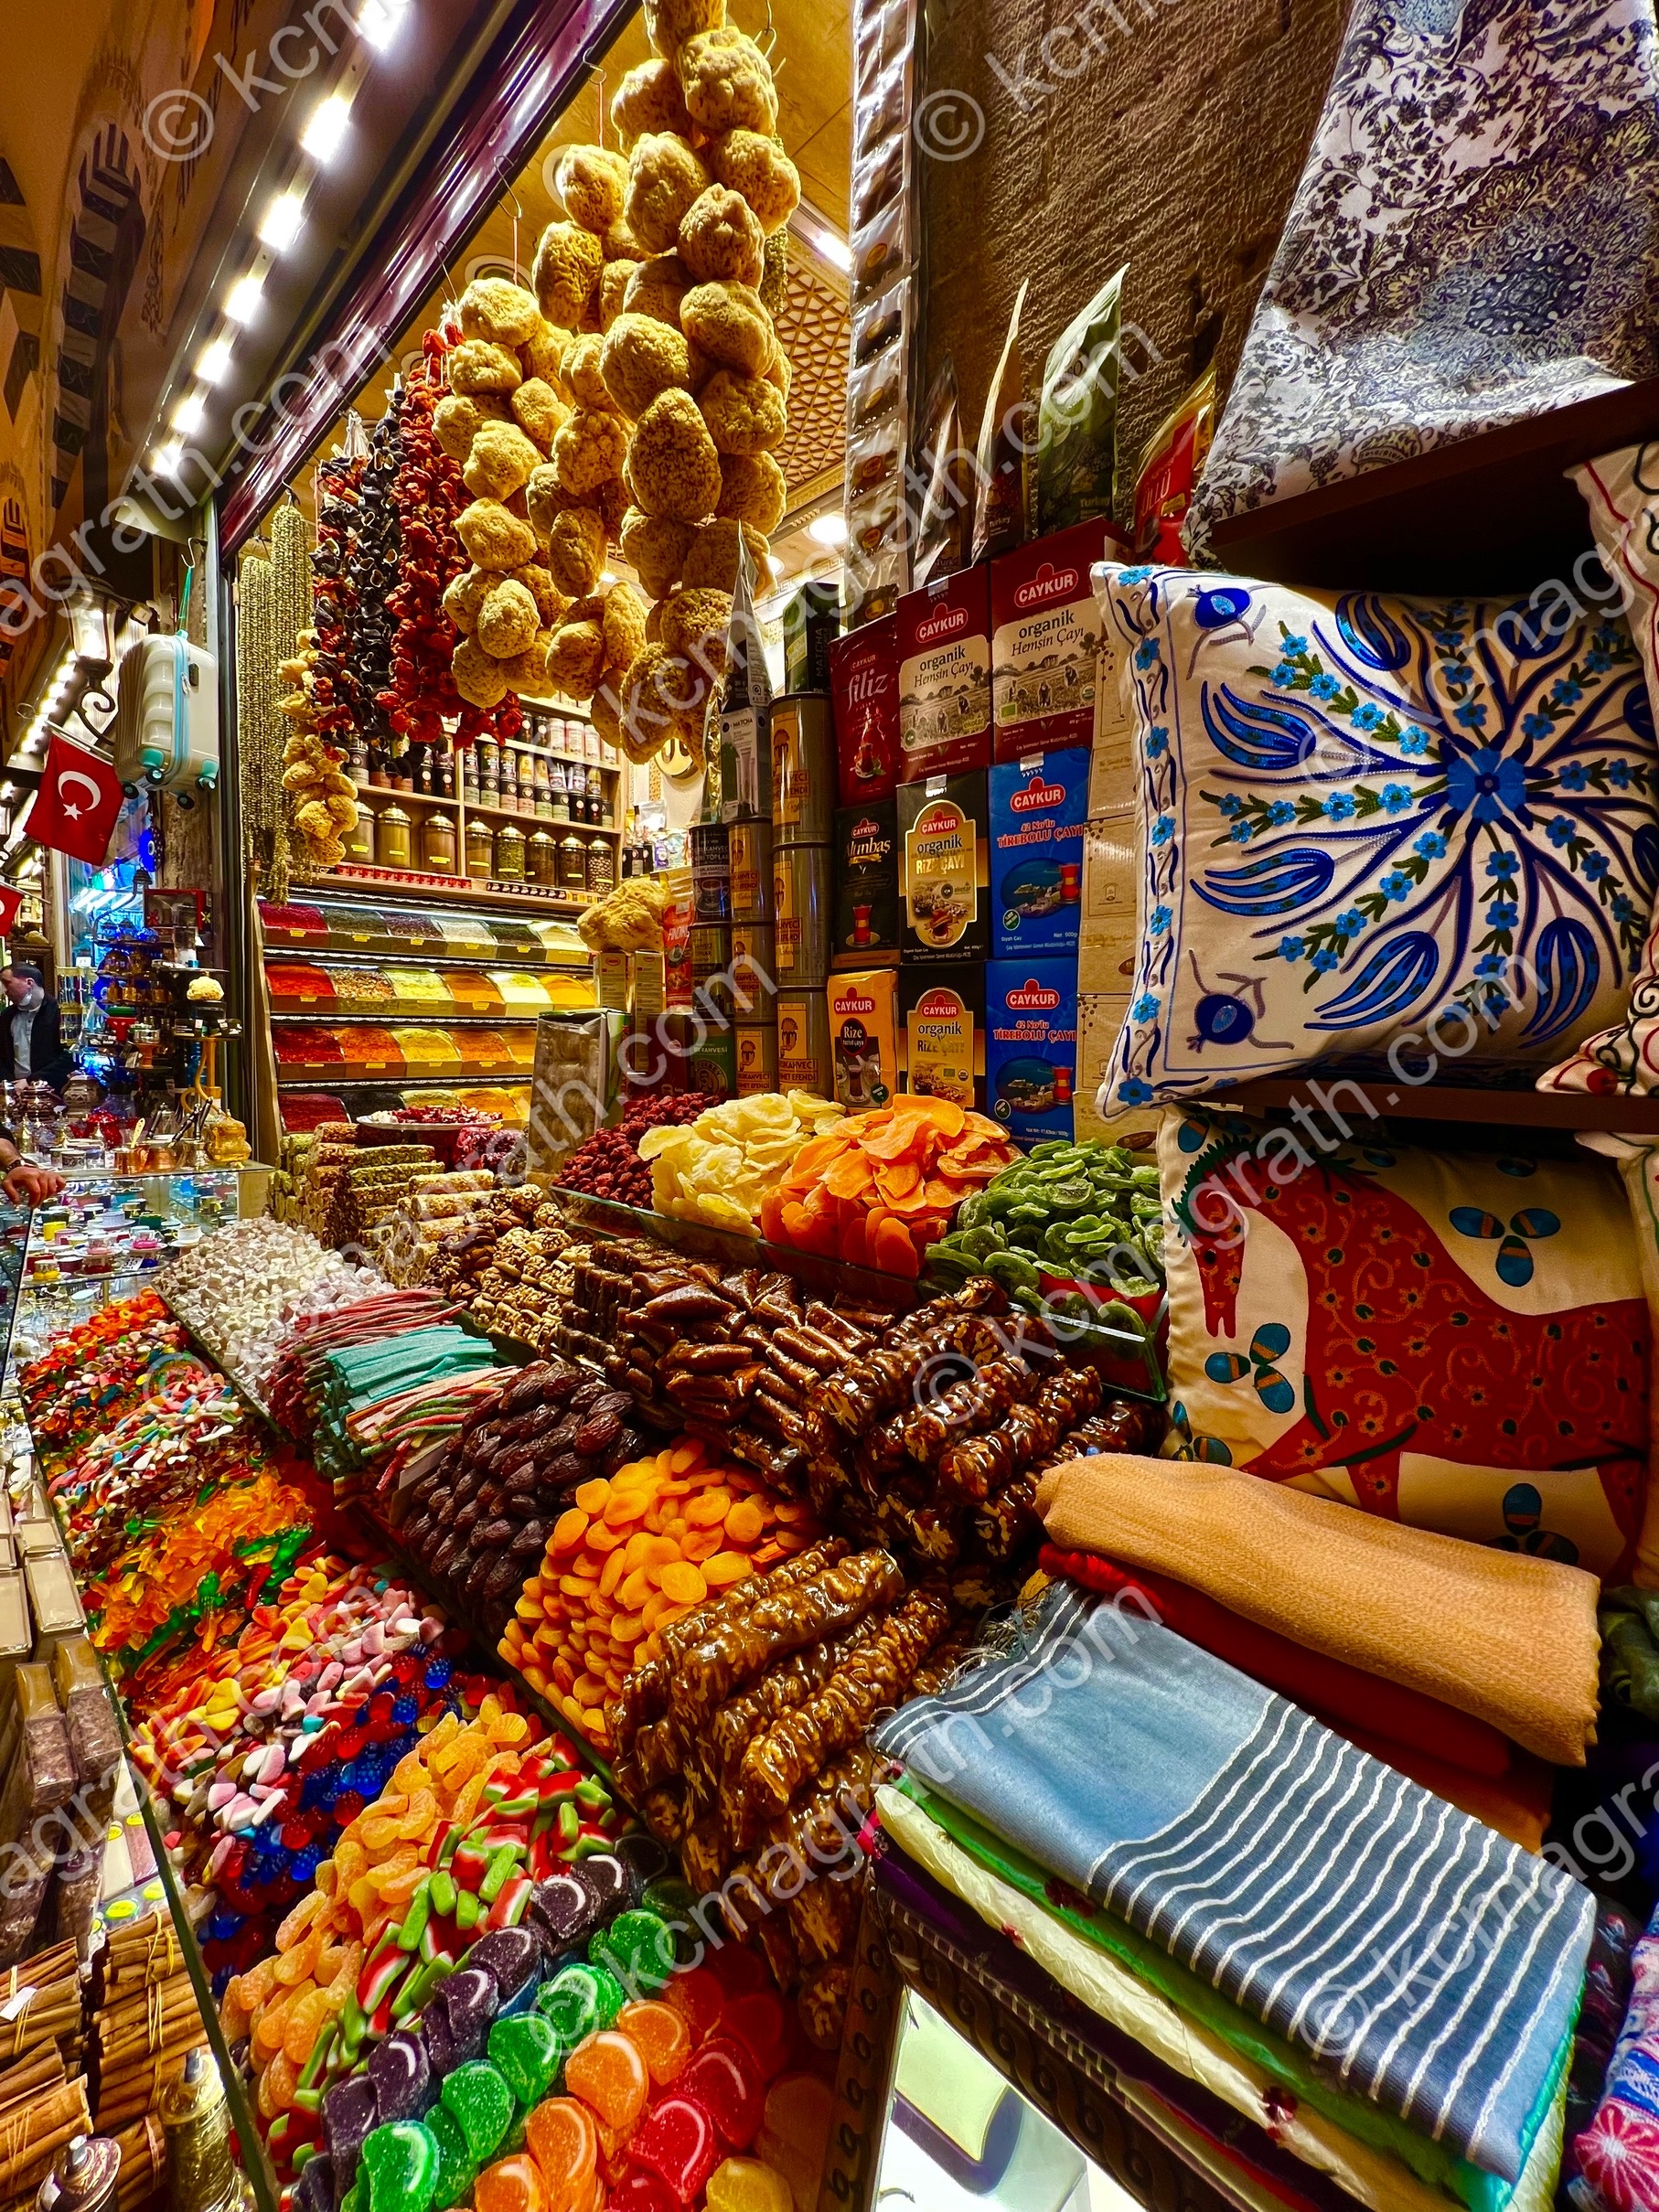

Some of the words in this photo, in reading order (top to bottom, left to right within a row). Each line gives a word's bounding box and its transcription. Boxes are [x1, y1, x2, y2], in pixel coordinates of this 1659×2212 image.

[1019, 573, 1074, 604] ÇAYKUR
[1018, 609, 1076, 639] organik
[815, 627, 825, 678] MATCHA
[1011, 635, 1054, 657] Hemşin
[1056, 625, 1084, 647] Çayı
[919, 645, 967, 672] organik
[914, 668, 948, 688] Hemşin
[950, 660, 974, 679] Çayı
[846, 668, 889, 713] filiz
[733, 717, 753, 728] MATCHA
[1013, 787, 1061, 811] ÇAYKUR
[916, 834, 963, 855] organik
[843, 1026, 862, 1039] Rize
[917, 1021, 962, 1038] organik
